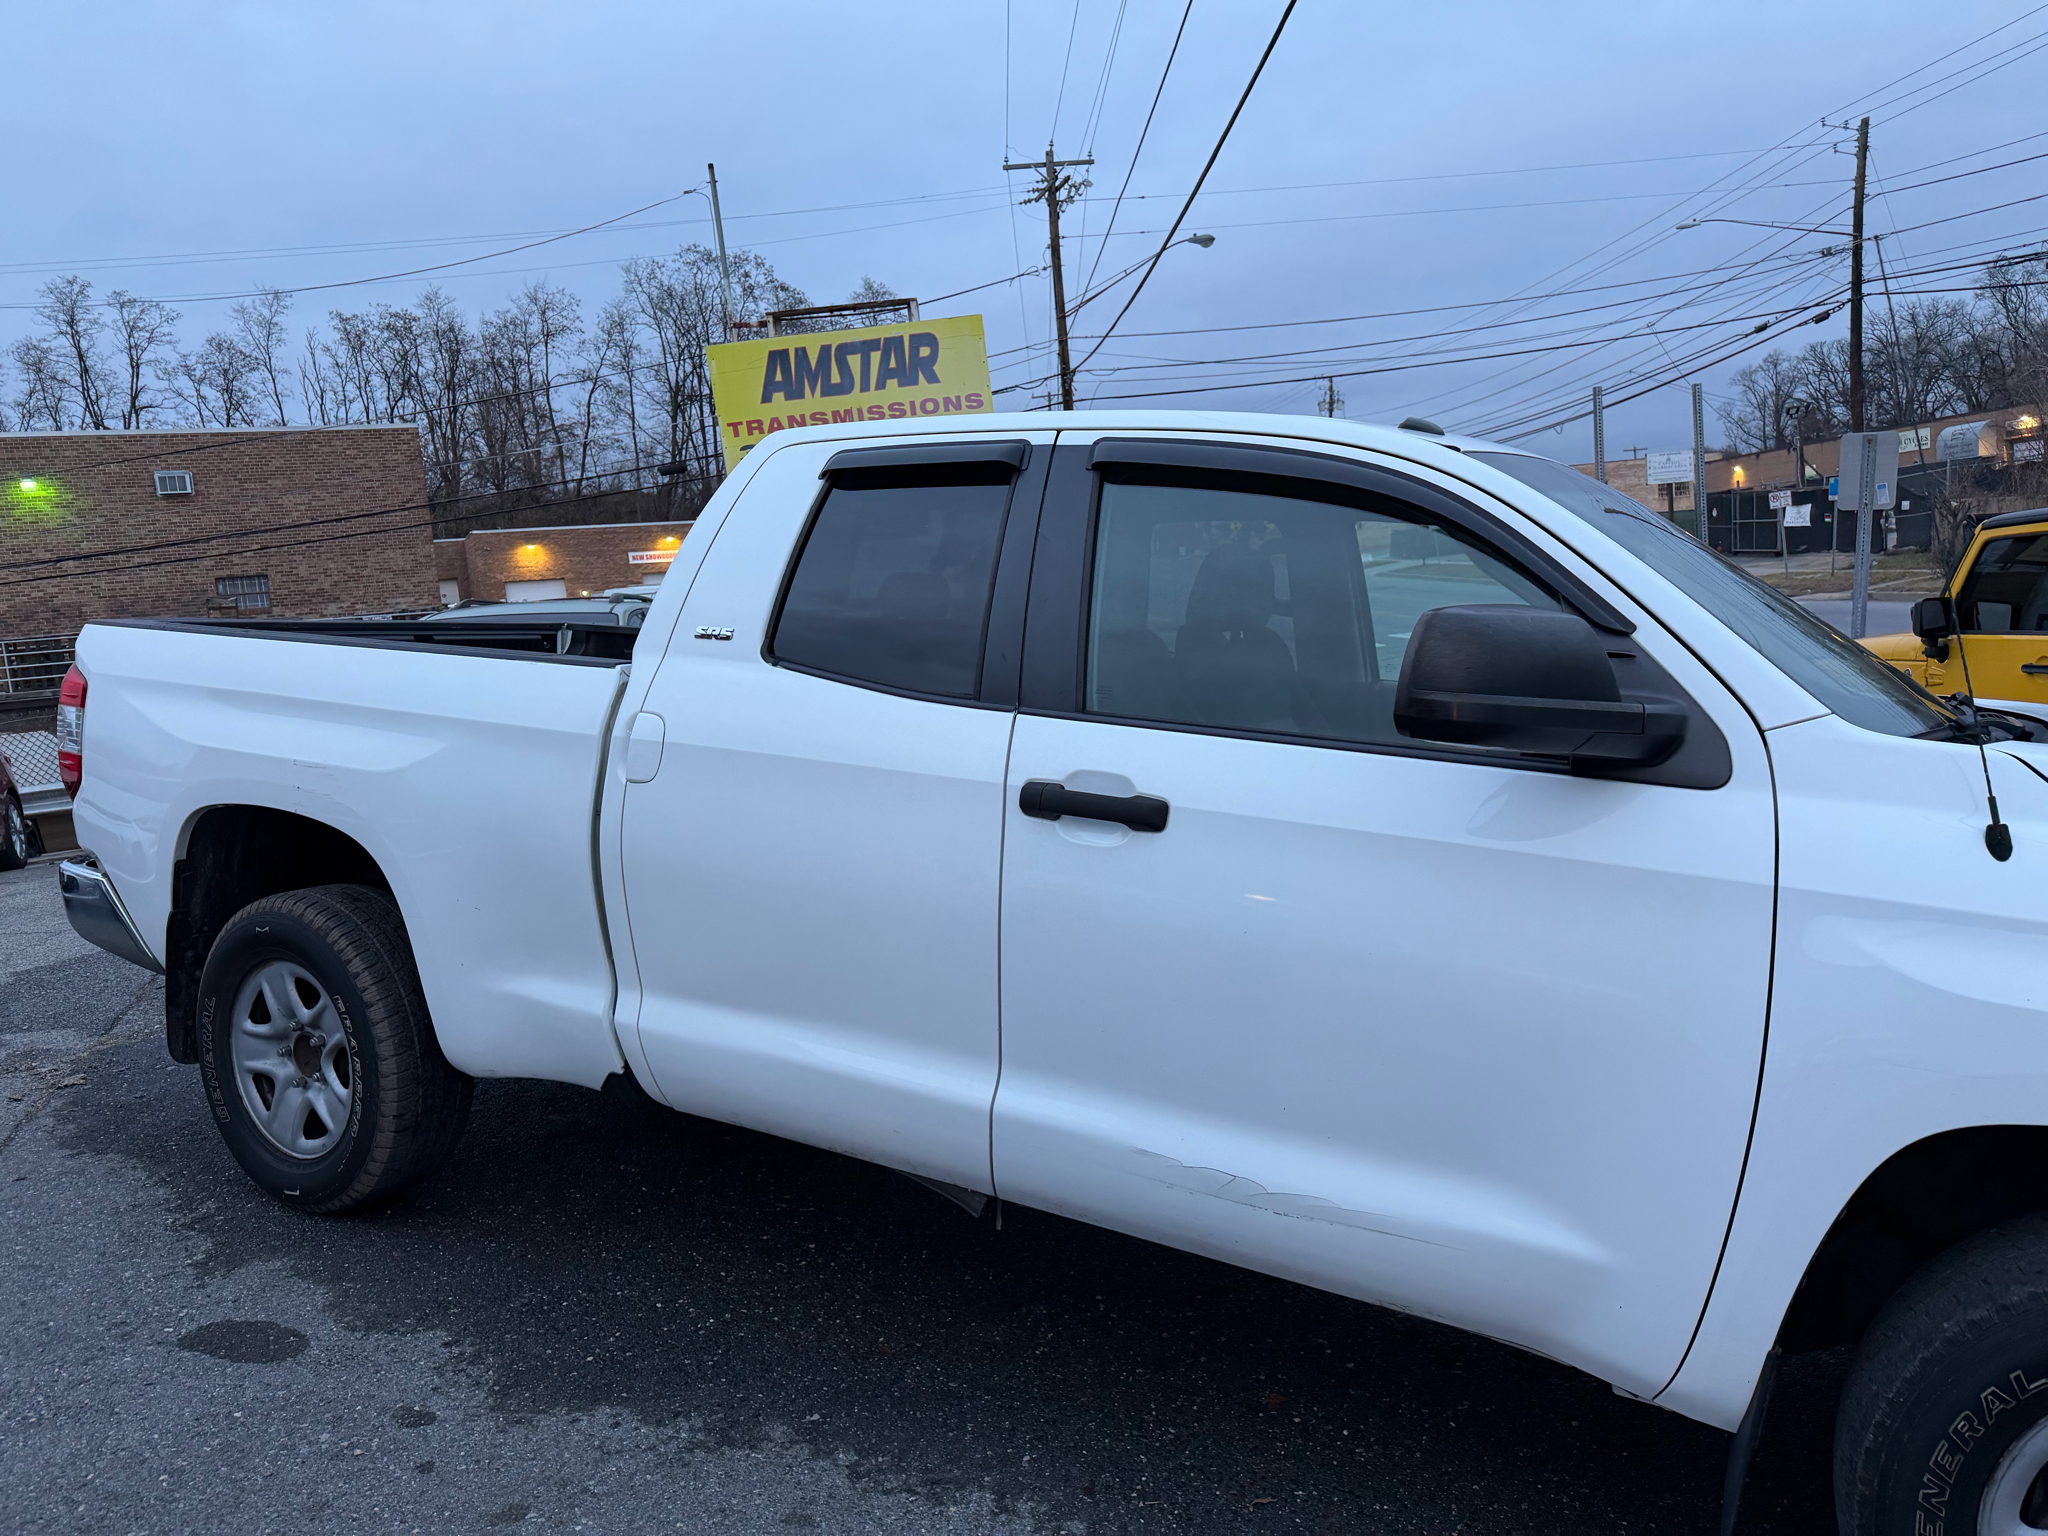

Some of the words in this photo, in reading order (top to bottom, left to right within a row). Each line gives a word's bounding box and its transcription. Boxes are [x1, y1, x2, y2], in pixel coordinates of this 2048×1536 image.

[760, 331, 941, 404] AMSTAR
[726, 392, 985, 438] TRANSMISSIONS
[631, 553, 645, 562] NEW
[694, 625, 735, 641] SR5
[202, 996, 231, 1124] GENERAL
